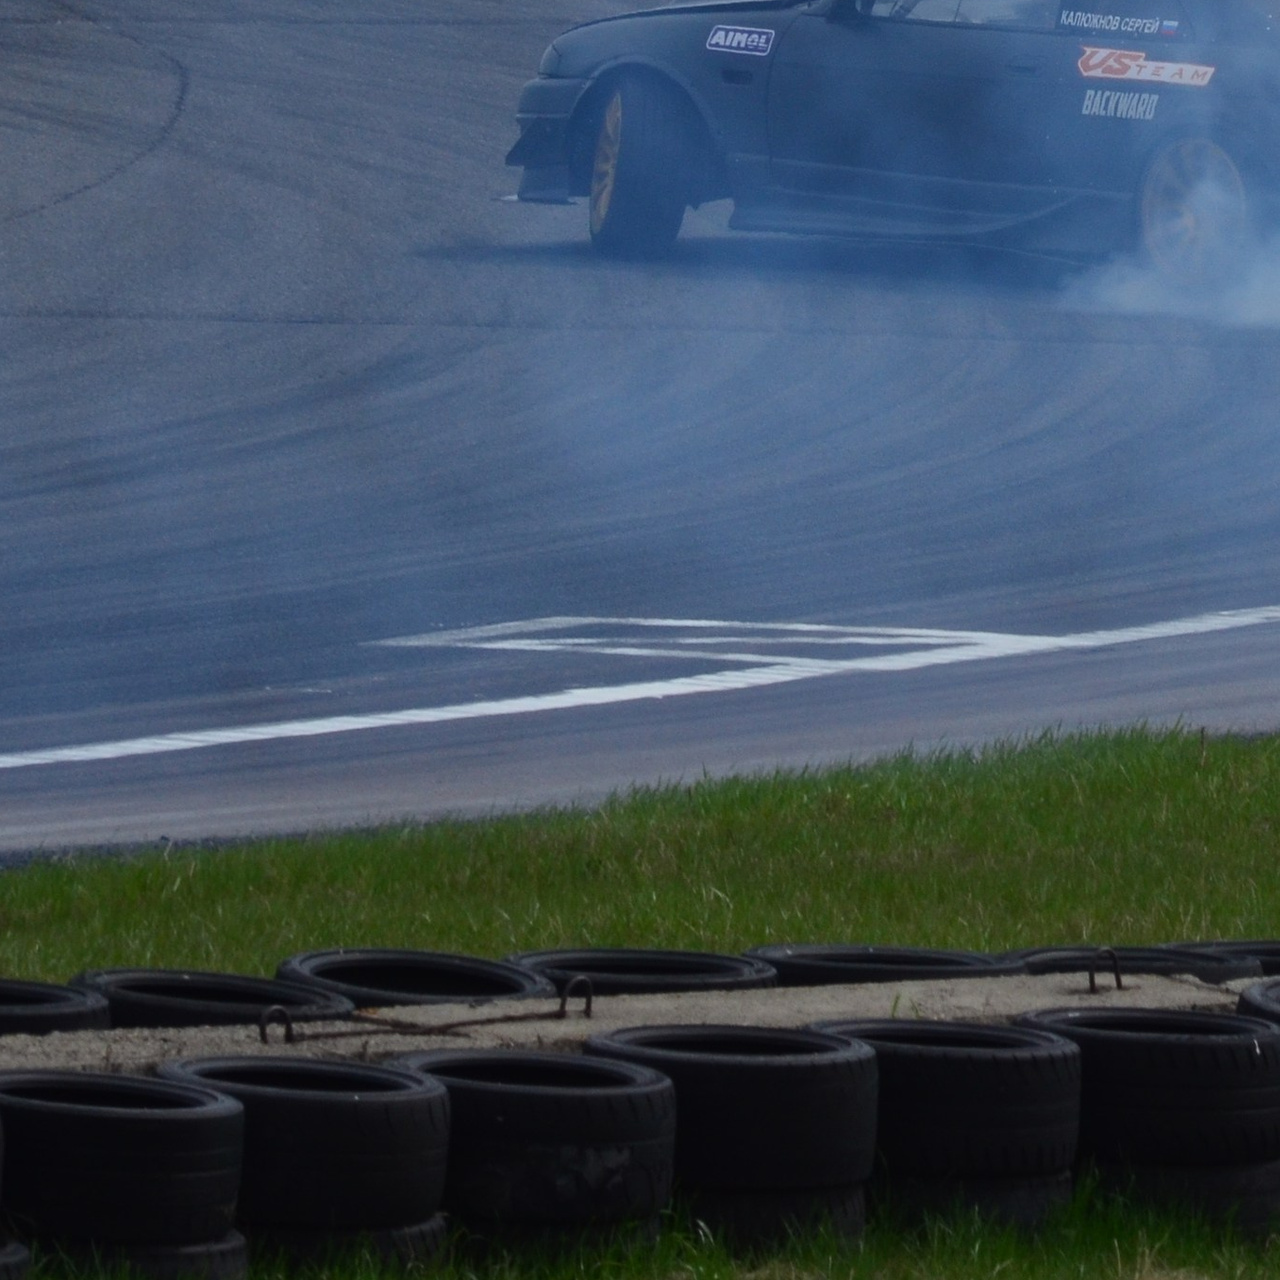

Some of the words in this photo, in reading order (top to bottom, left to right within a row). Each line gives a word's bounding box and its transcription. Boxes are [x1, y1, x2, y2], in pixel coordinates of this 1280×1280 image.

[1060, 10, 1120, 30] КАЛЮЖНОВ
[1121, 17, 1160, 34] СЕРГЕЙ
[711, 30, 768, 48] AIMOL
[1135, 64, 1208, 81] TEAM
[1082, 89, 1159, 120] BACKWARD
